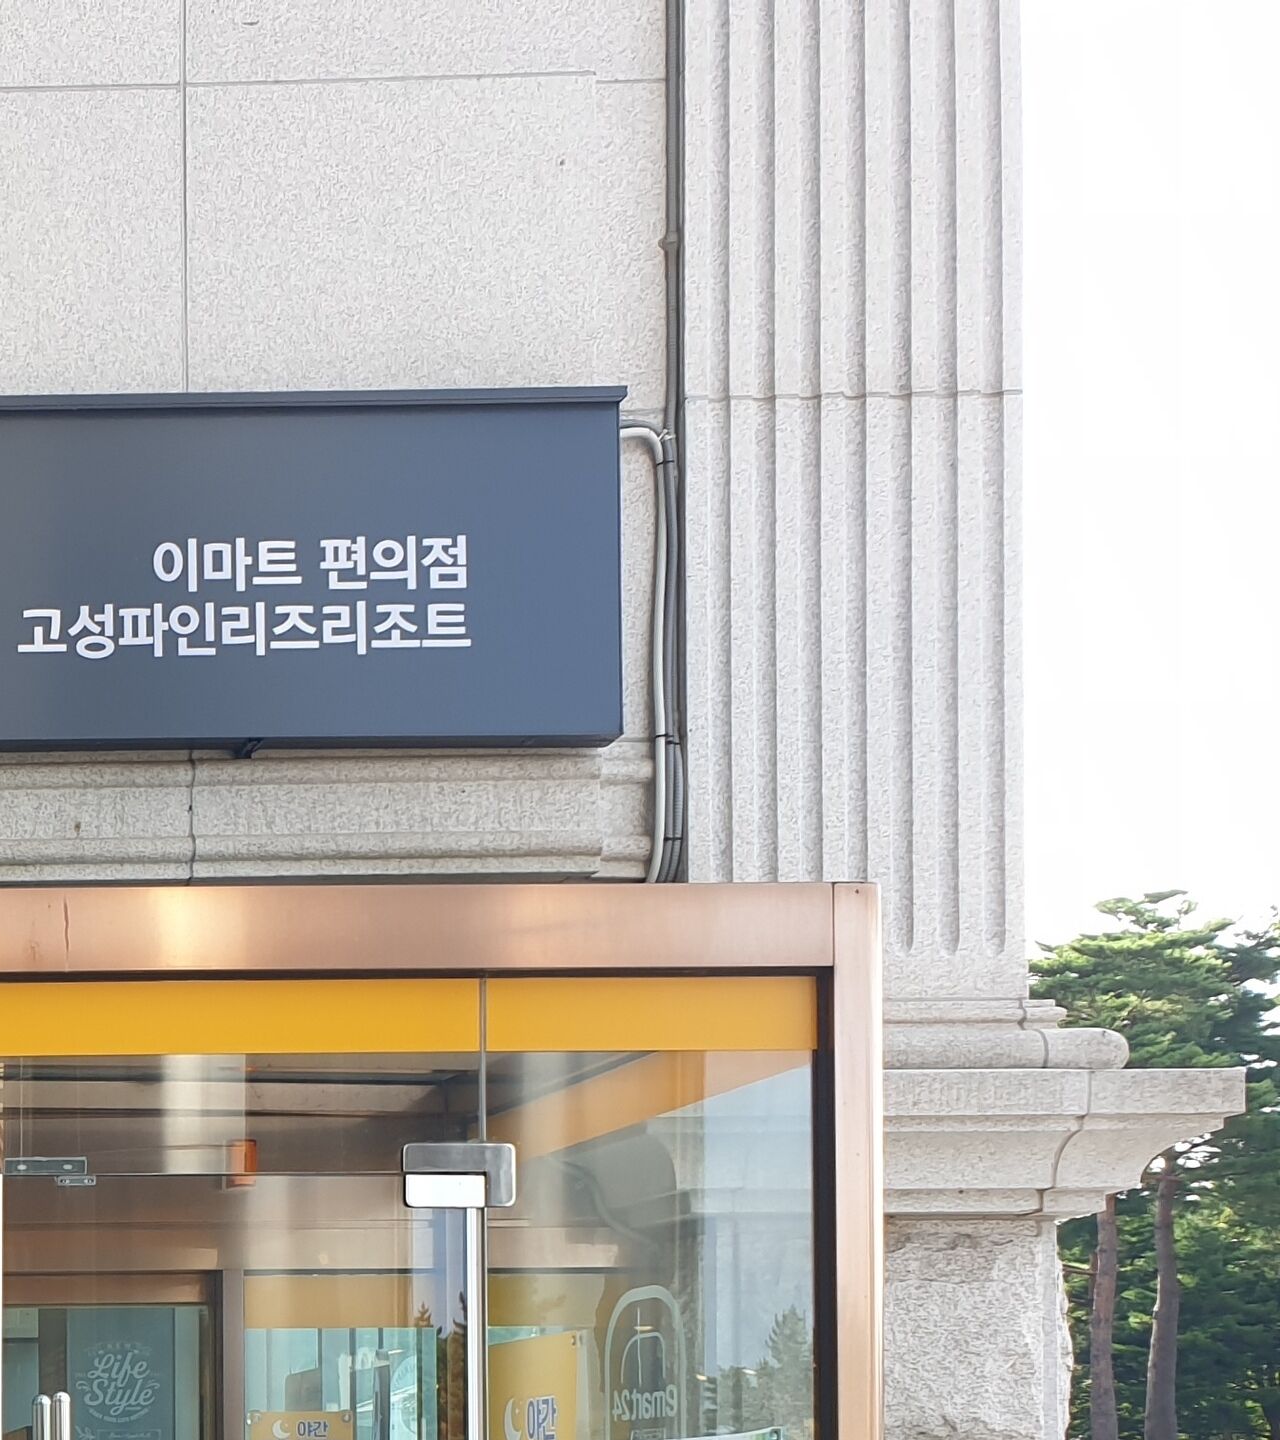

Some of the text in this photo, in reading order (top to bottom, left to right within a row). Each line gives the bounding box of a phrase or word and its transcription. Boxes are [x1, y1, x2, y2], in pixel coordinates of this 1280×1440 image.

[153, 535, 469, 592] 이마트 편의점
[17, 600, 472, 660] 고성파인리즈리조트
[87, 1352, 150, 1387] Life
[84, 1379, 157, 1415] Style
[297, 1420, 328, 1438] 야간
[527, 1398, 557, 1440] 야간
